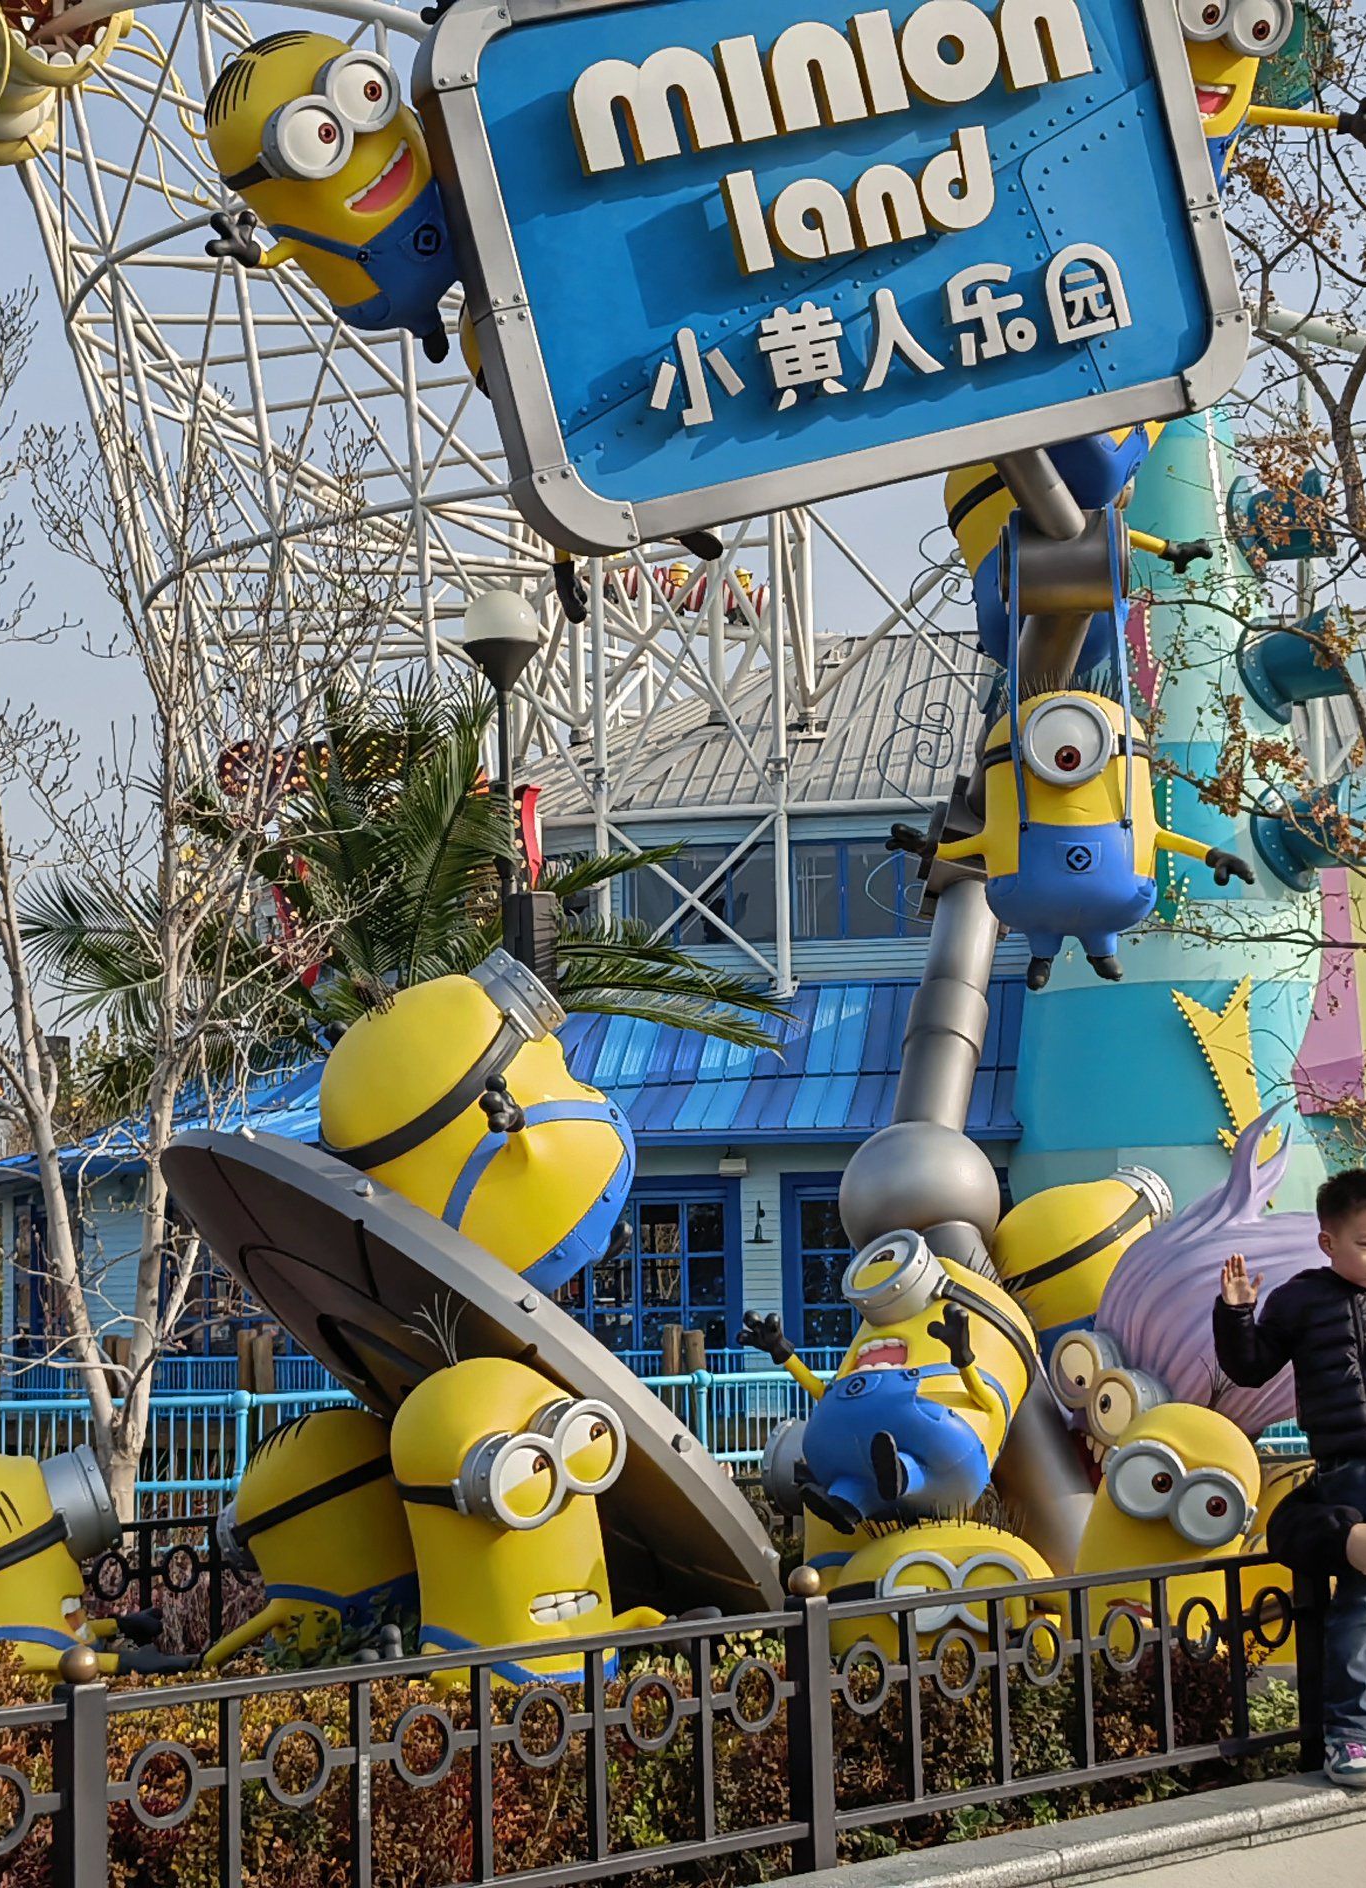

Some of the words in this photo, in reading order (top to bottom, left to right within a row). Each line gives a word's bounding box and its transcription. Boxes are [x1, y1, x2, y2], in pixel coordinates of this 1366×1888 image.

[572, 0, 1094, 175] minion
[723, 125, 994, 274] land
[650, 243, 1130, 427] 小黄人乐园
